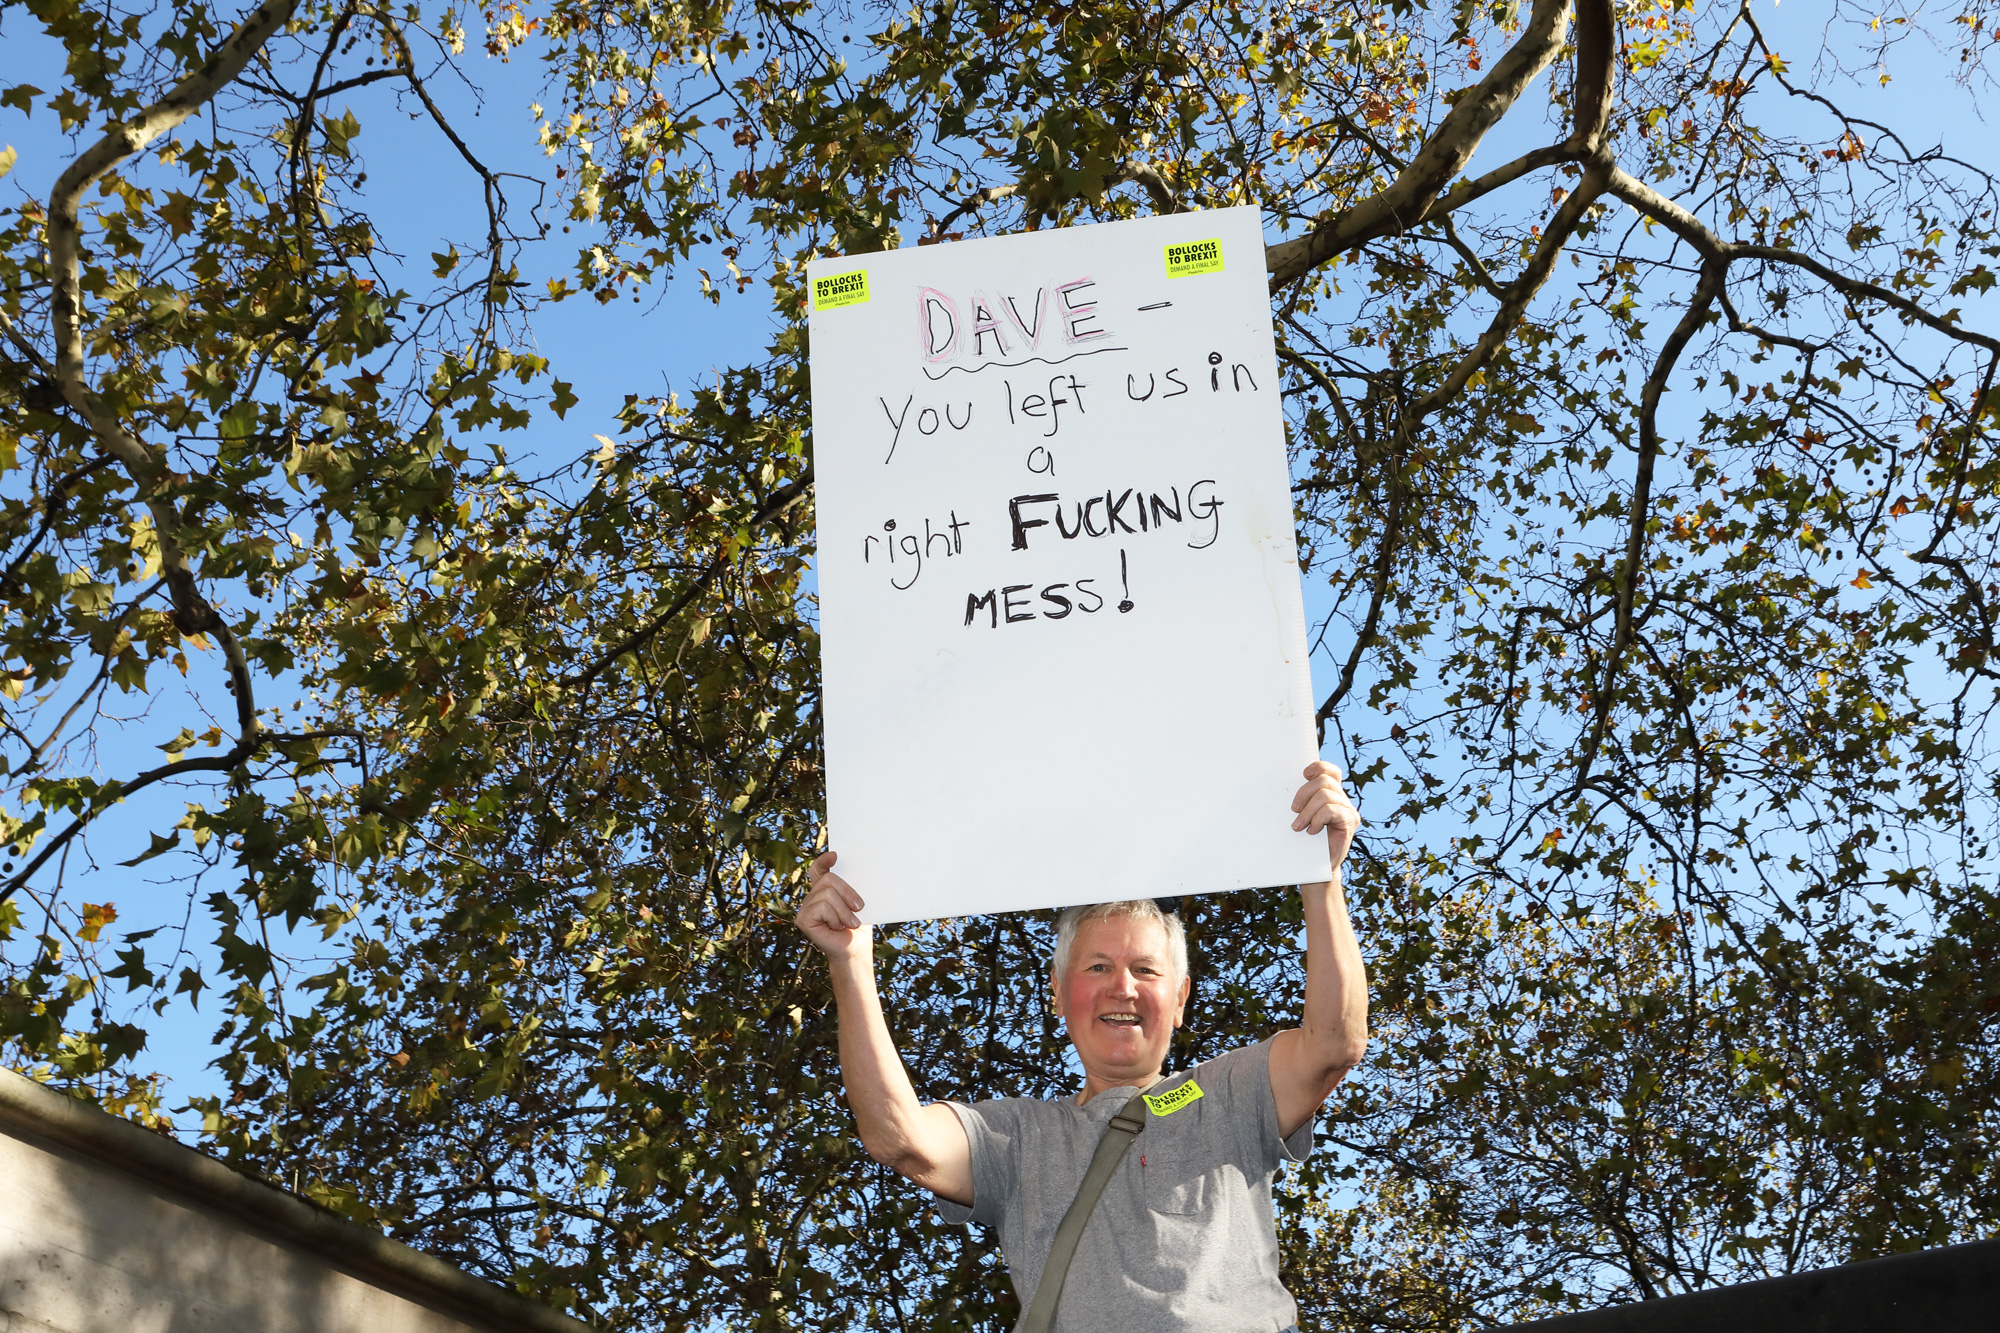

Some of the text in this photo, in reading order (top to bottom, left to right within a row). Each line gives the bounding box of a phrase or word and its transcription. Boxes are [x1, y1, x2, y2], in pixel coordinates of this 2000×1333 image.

[1168, 242, 1216, 256] BOLLOCKS
[1169, 250, 1217, 264] TO BREXIT
[817, 273, 862, 289] BOLLOCKS
[817, 282, 863, 297] TO BREXIT
[818, 296, 837, 305] DEMAND
[917, 276, 1115, 363] DAVE
[1005, 375, 1086, 436] left
[1127, 368, 1188, 401] us
[1207, 351, 1258, 392] in
[1026, 446, 1055, 476] a
[863, 480, 1225, 590] right FUCKING
[964, 549, 1134, 628] MESS!
[1148, 1084, 1189, 1103] BOLLOCKS
[1164, 1086, 1193, 1105] BREXIT
